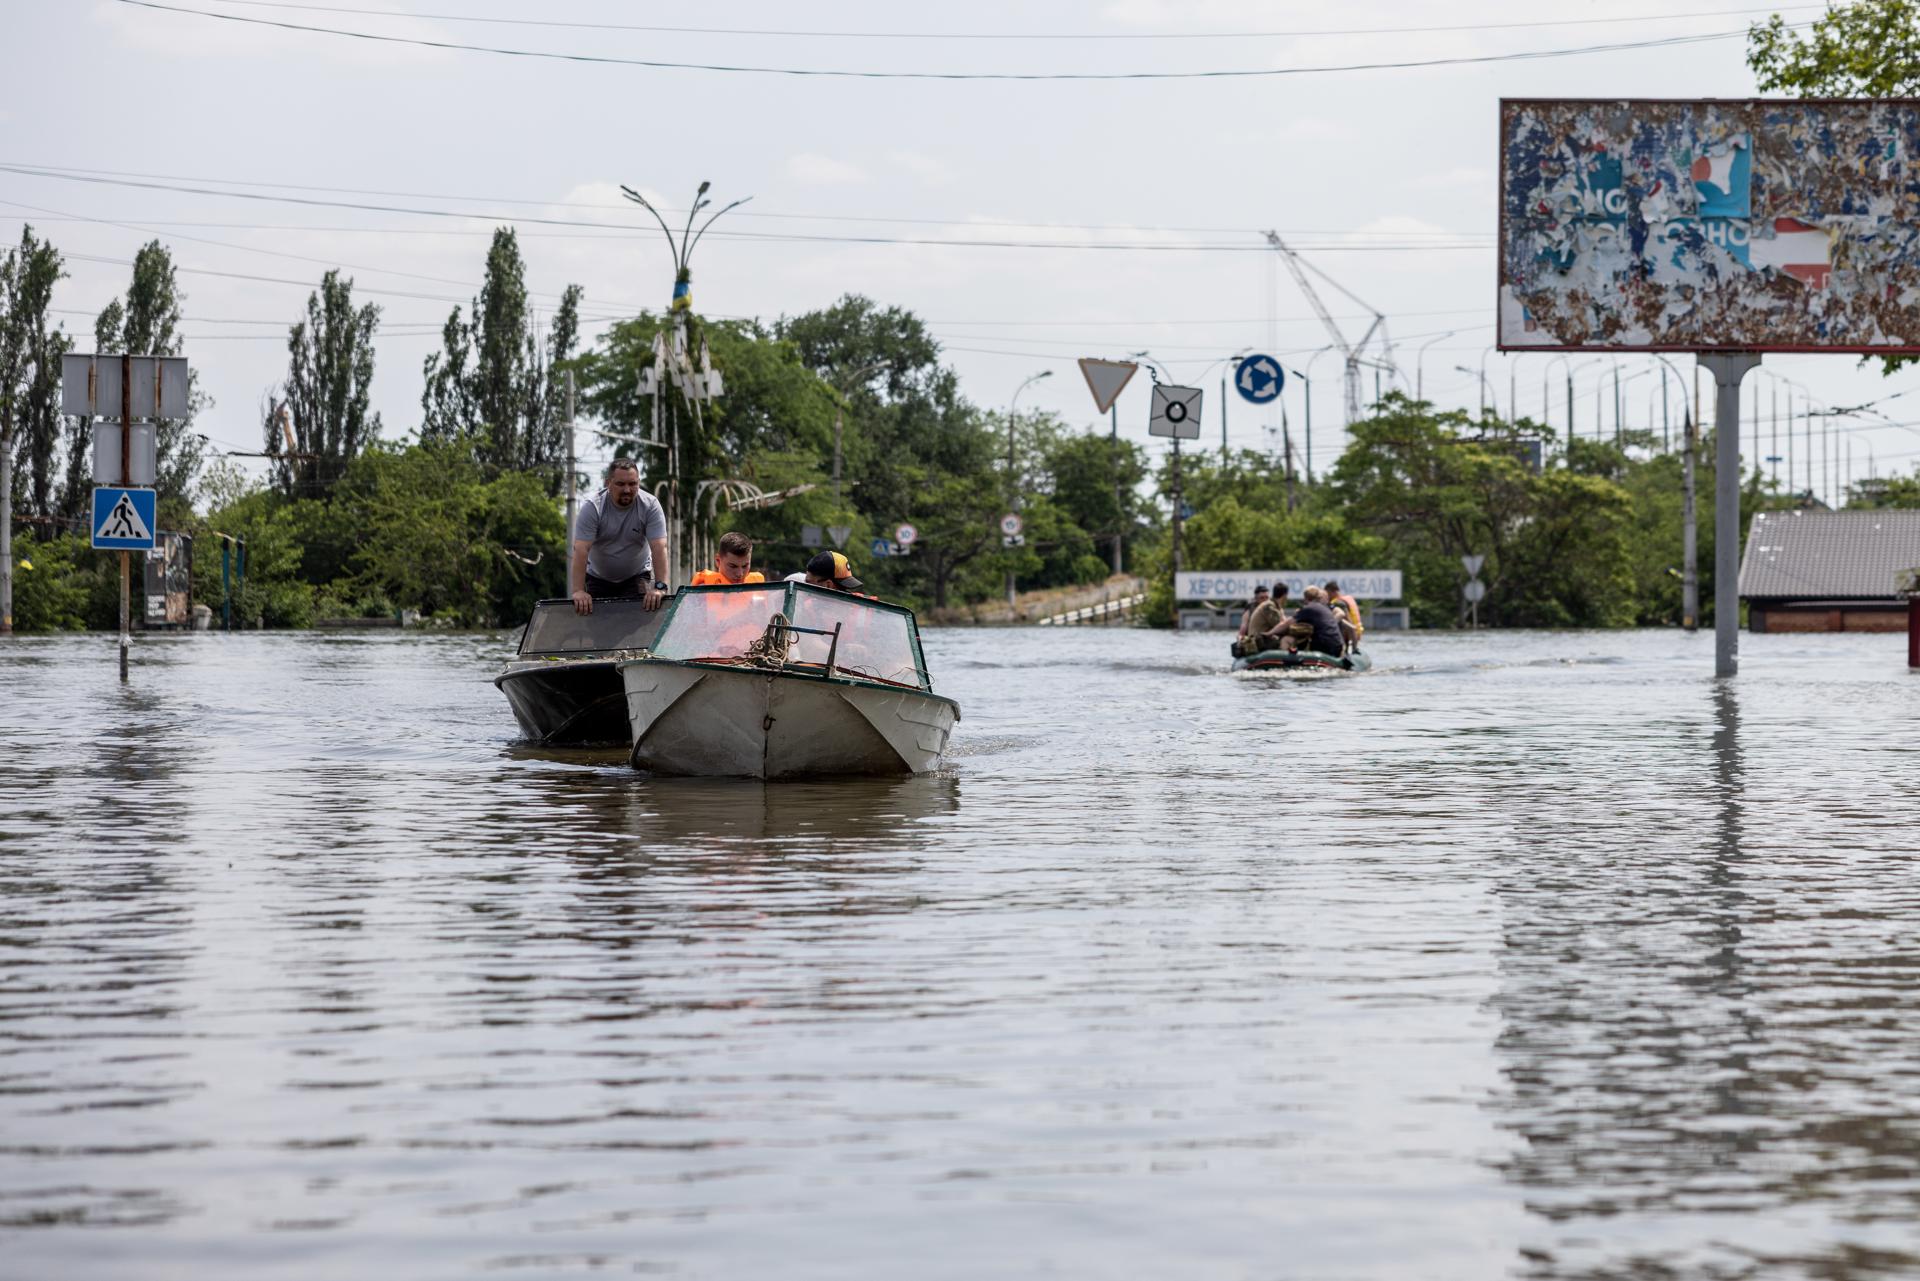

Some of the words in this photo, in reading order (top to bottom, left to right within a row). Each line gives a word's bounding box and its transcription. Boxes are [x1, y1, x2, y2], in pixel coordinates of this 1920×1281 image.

[1188, 577, 1248, 595] ХЕРСОН
[1255, 578, 1304, 595] ІТО
[1308, 577, 1392, 595] ОАБЕЛІВ
